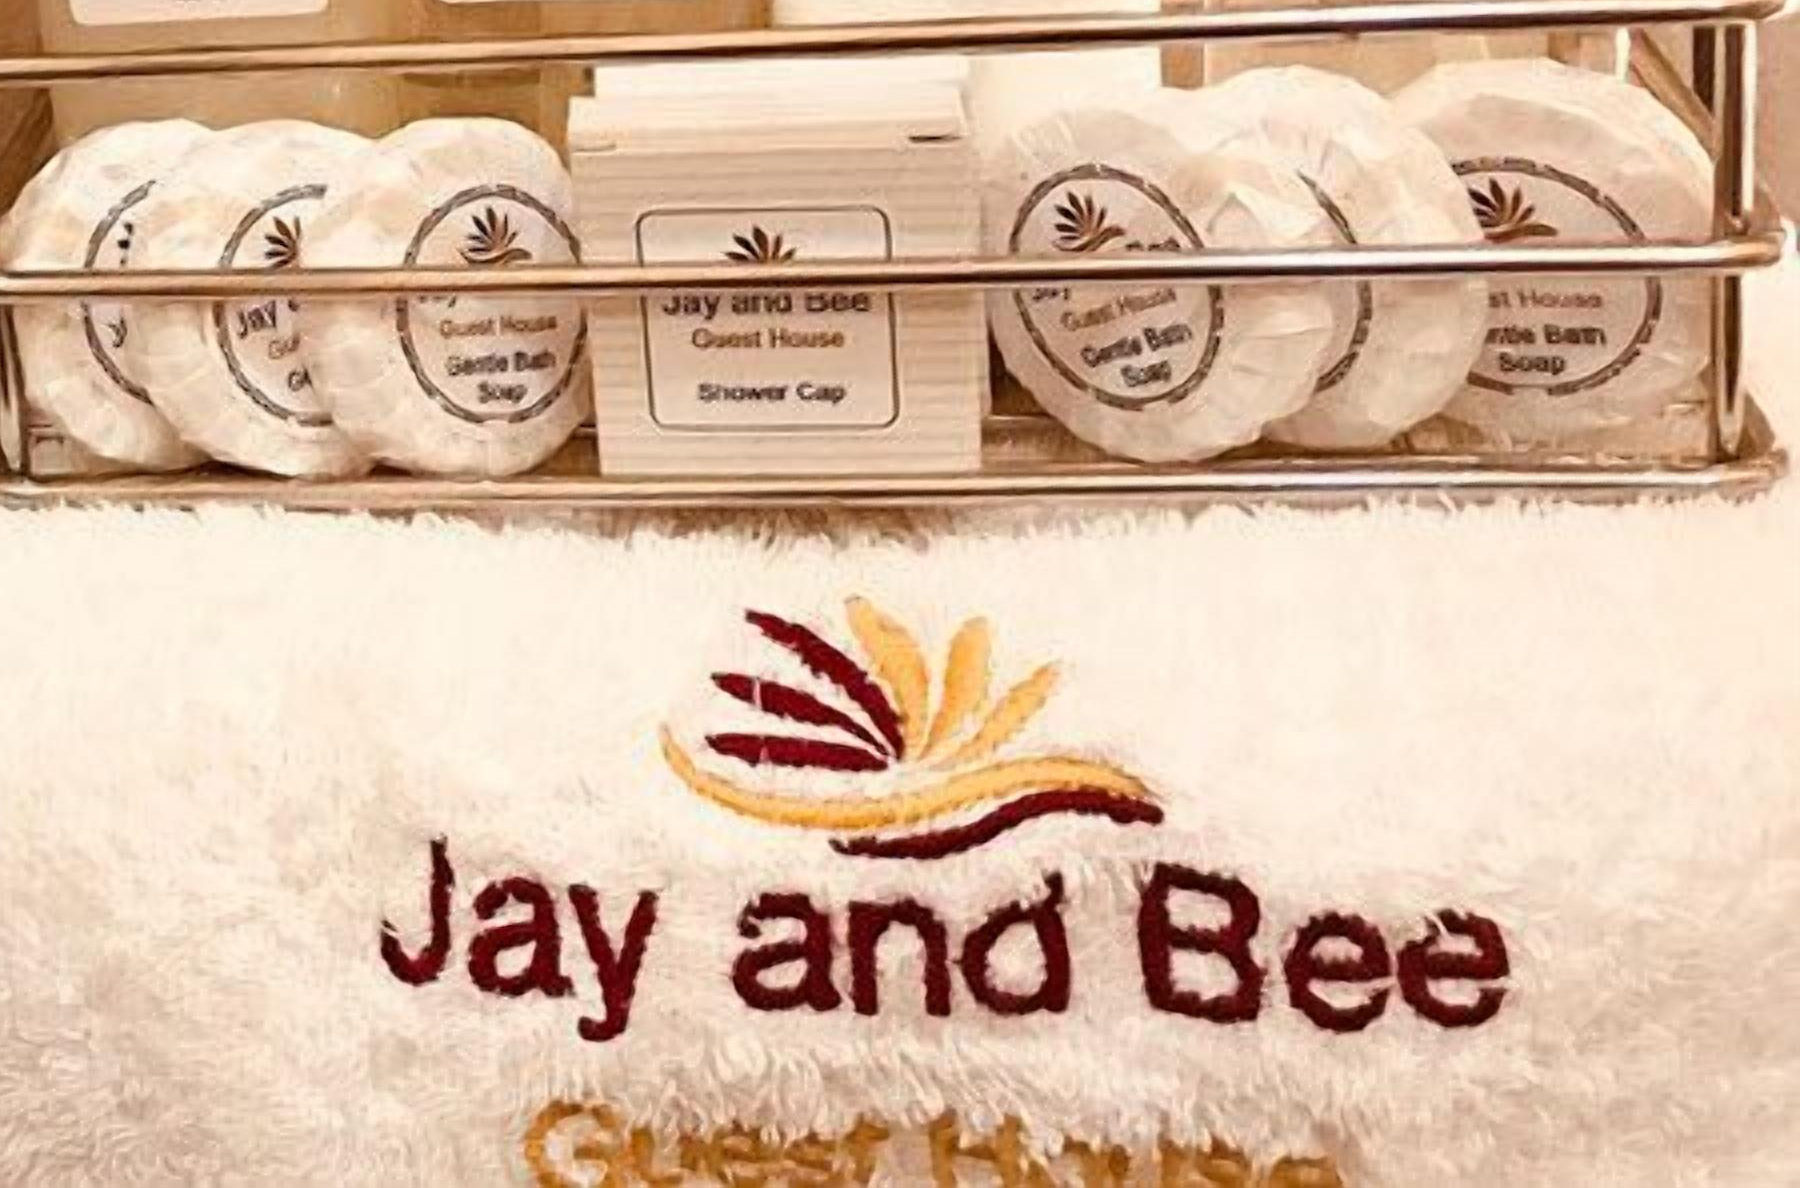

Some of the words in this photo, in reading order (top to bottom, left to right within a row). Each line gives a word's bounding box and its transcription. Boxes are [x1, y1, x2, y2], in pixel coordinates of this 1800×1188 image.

[692, 328, 762, 350] Guest
[769, 328, 845, 349] House
[1499, 352, 1565, 376] Soap
[698, 383, 788, 402] Shower
[796, 382, 847, 406] Cap
[380, 834, 661, 1042] Jay
[731, 870, 1074, 1017] and
[1137, 861, 1512, 1035] Bee
